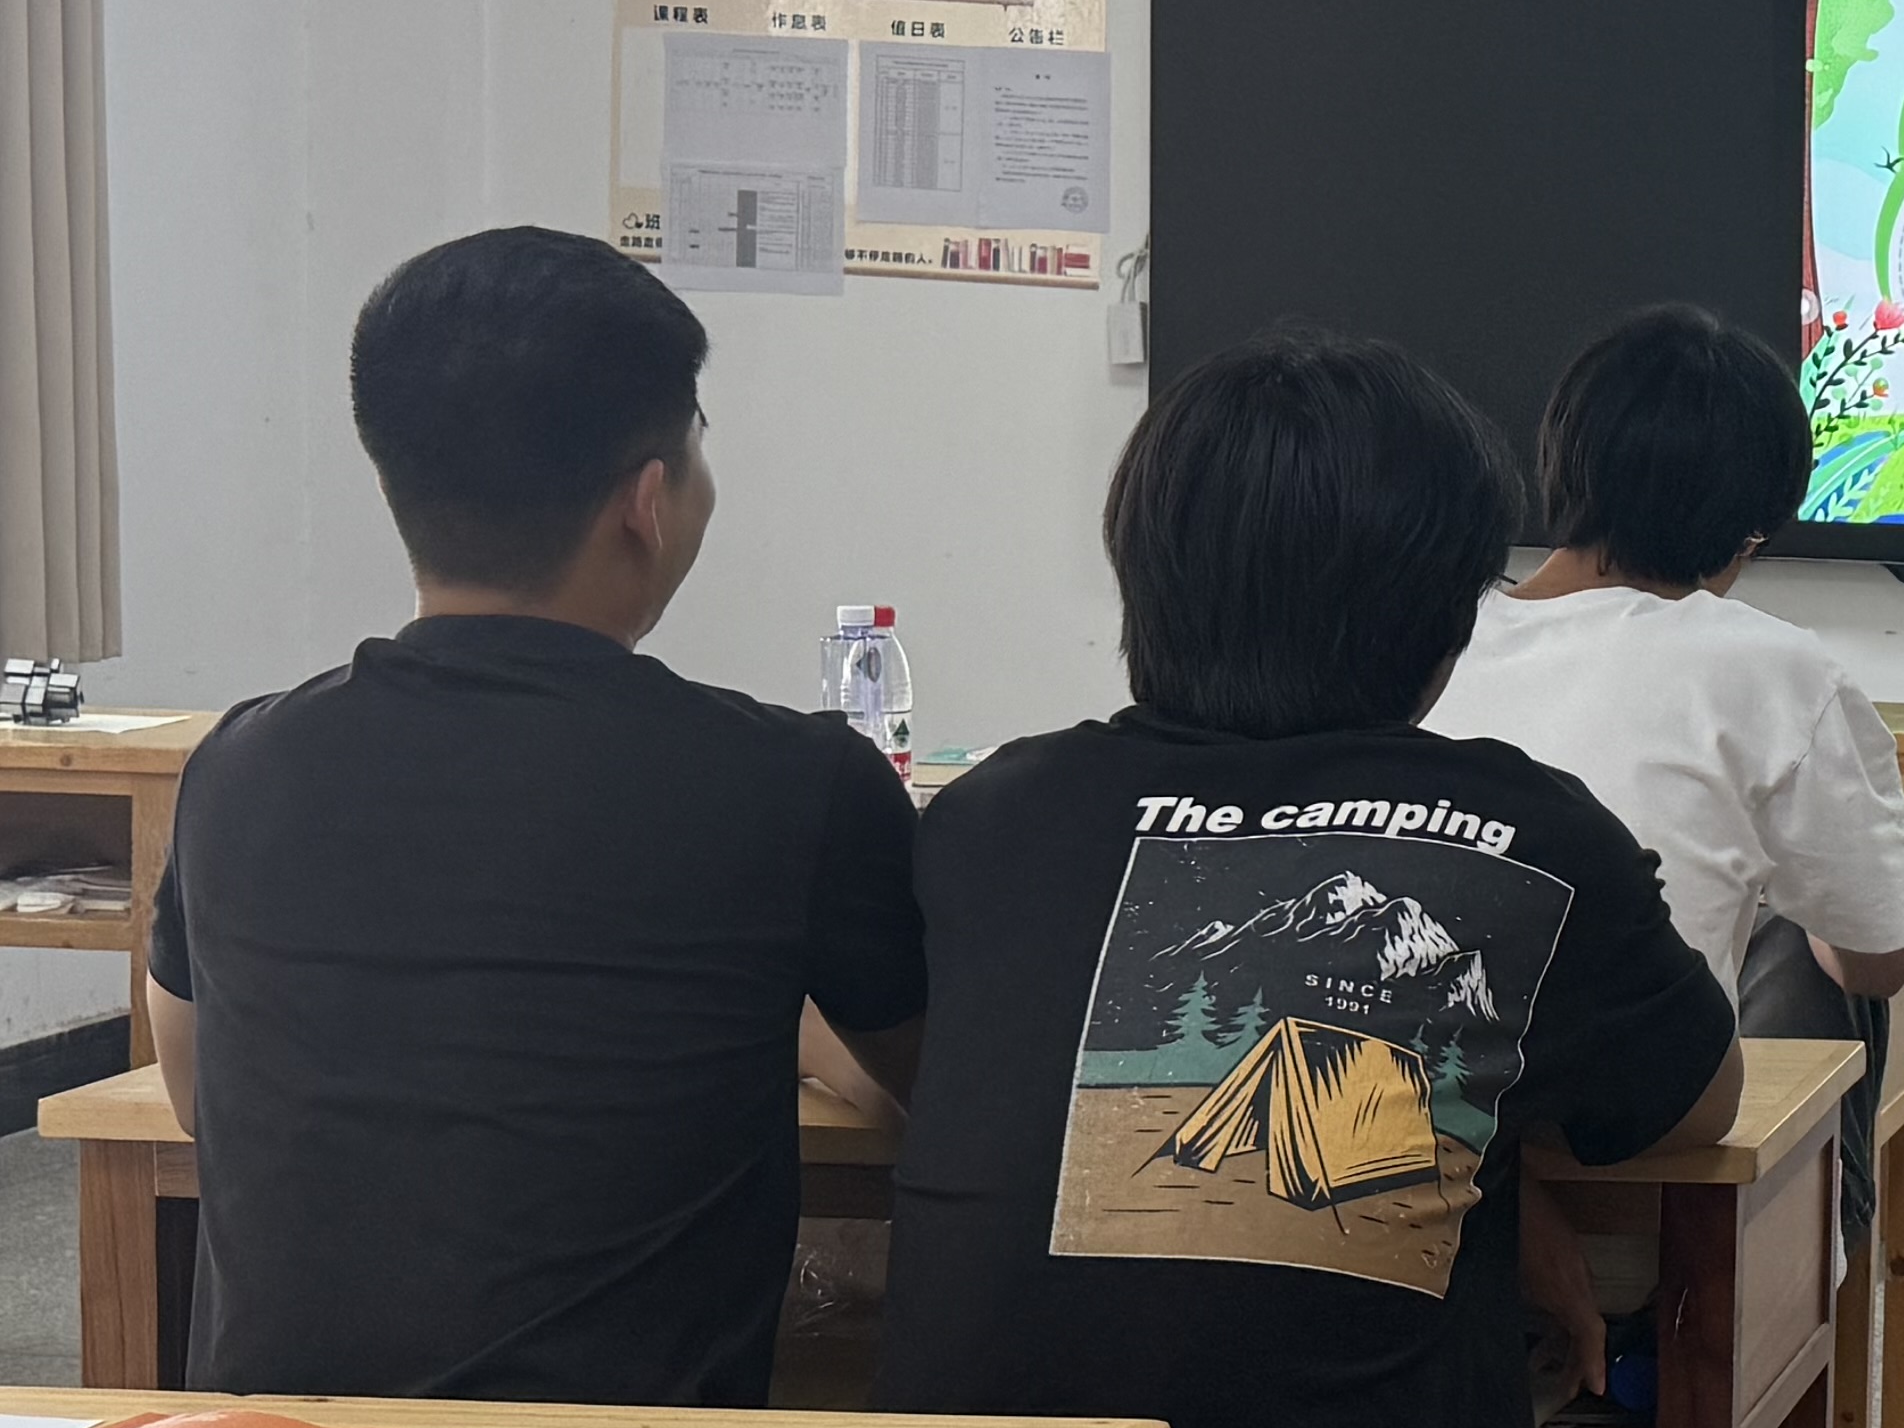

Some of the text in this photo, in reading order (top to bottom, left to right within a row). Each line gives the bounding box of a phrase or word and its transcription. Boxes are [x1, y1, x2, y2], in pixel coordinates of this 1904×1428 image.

[653, 4, 709, 25] 课程表
[772, 12, 827, 32] 作息表
[890, 20, 946, 39] 值日表
[1009, 27, 1065, 46] 公告栏
[1135, 796, 1517, 855] The camping
[1304, 973, 1392, 1004] SINCE
[1324, 995, 1370, 1015] 1991
